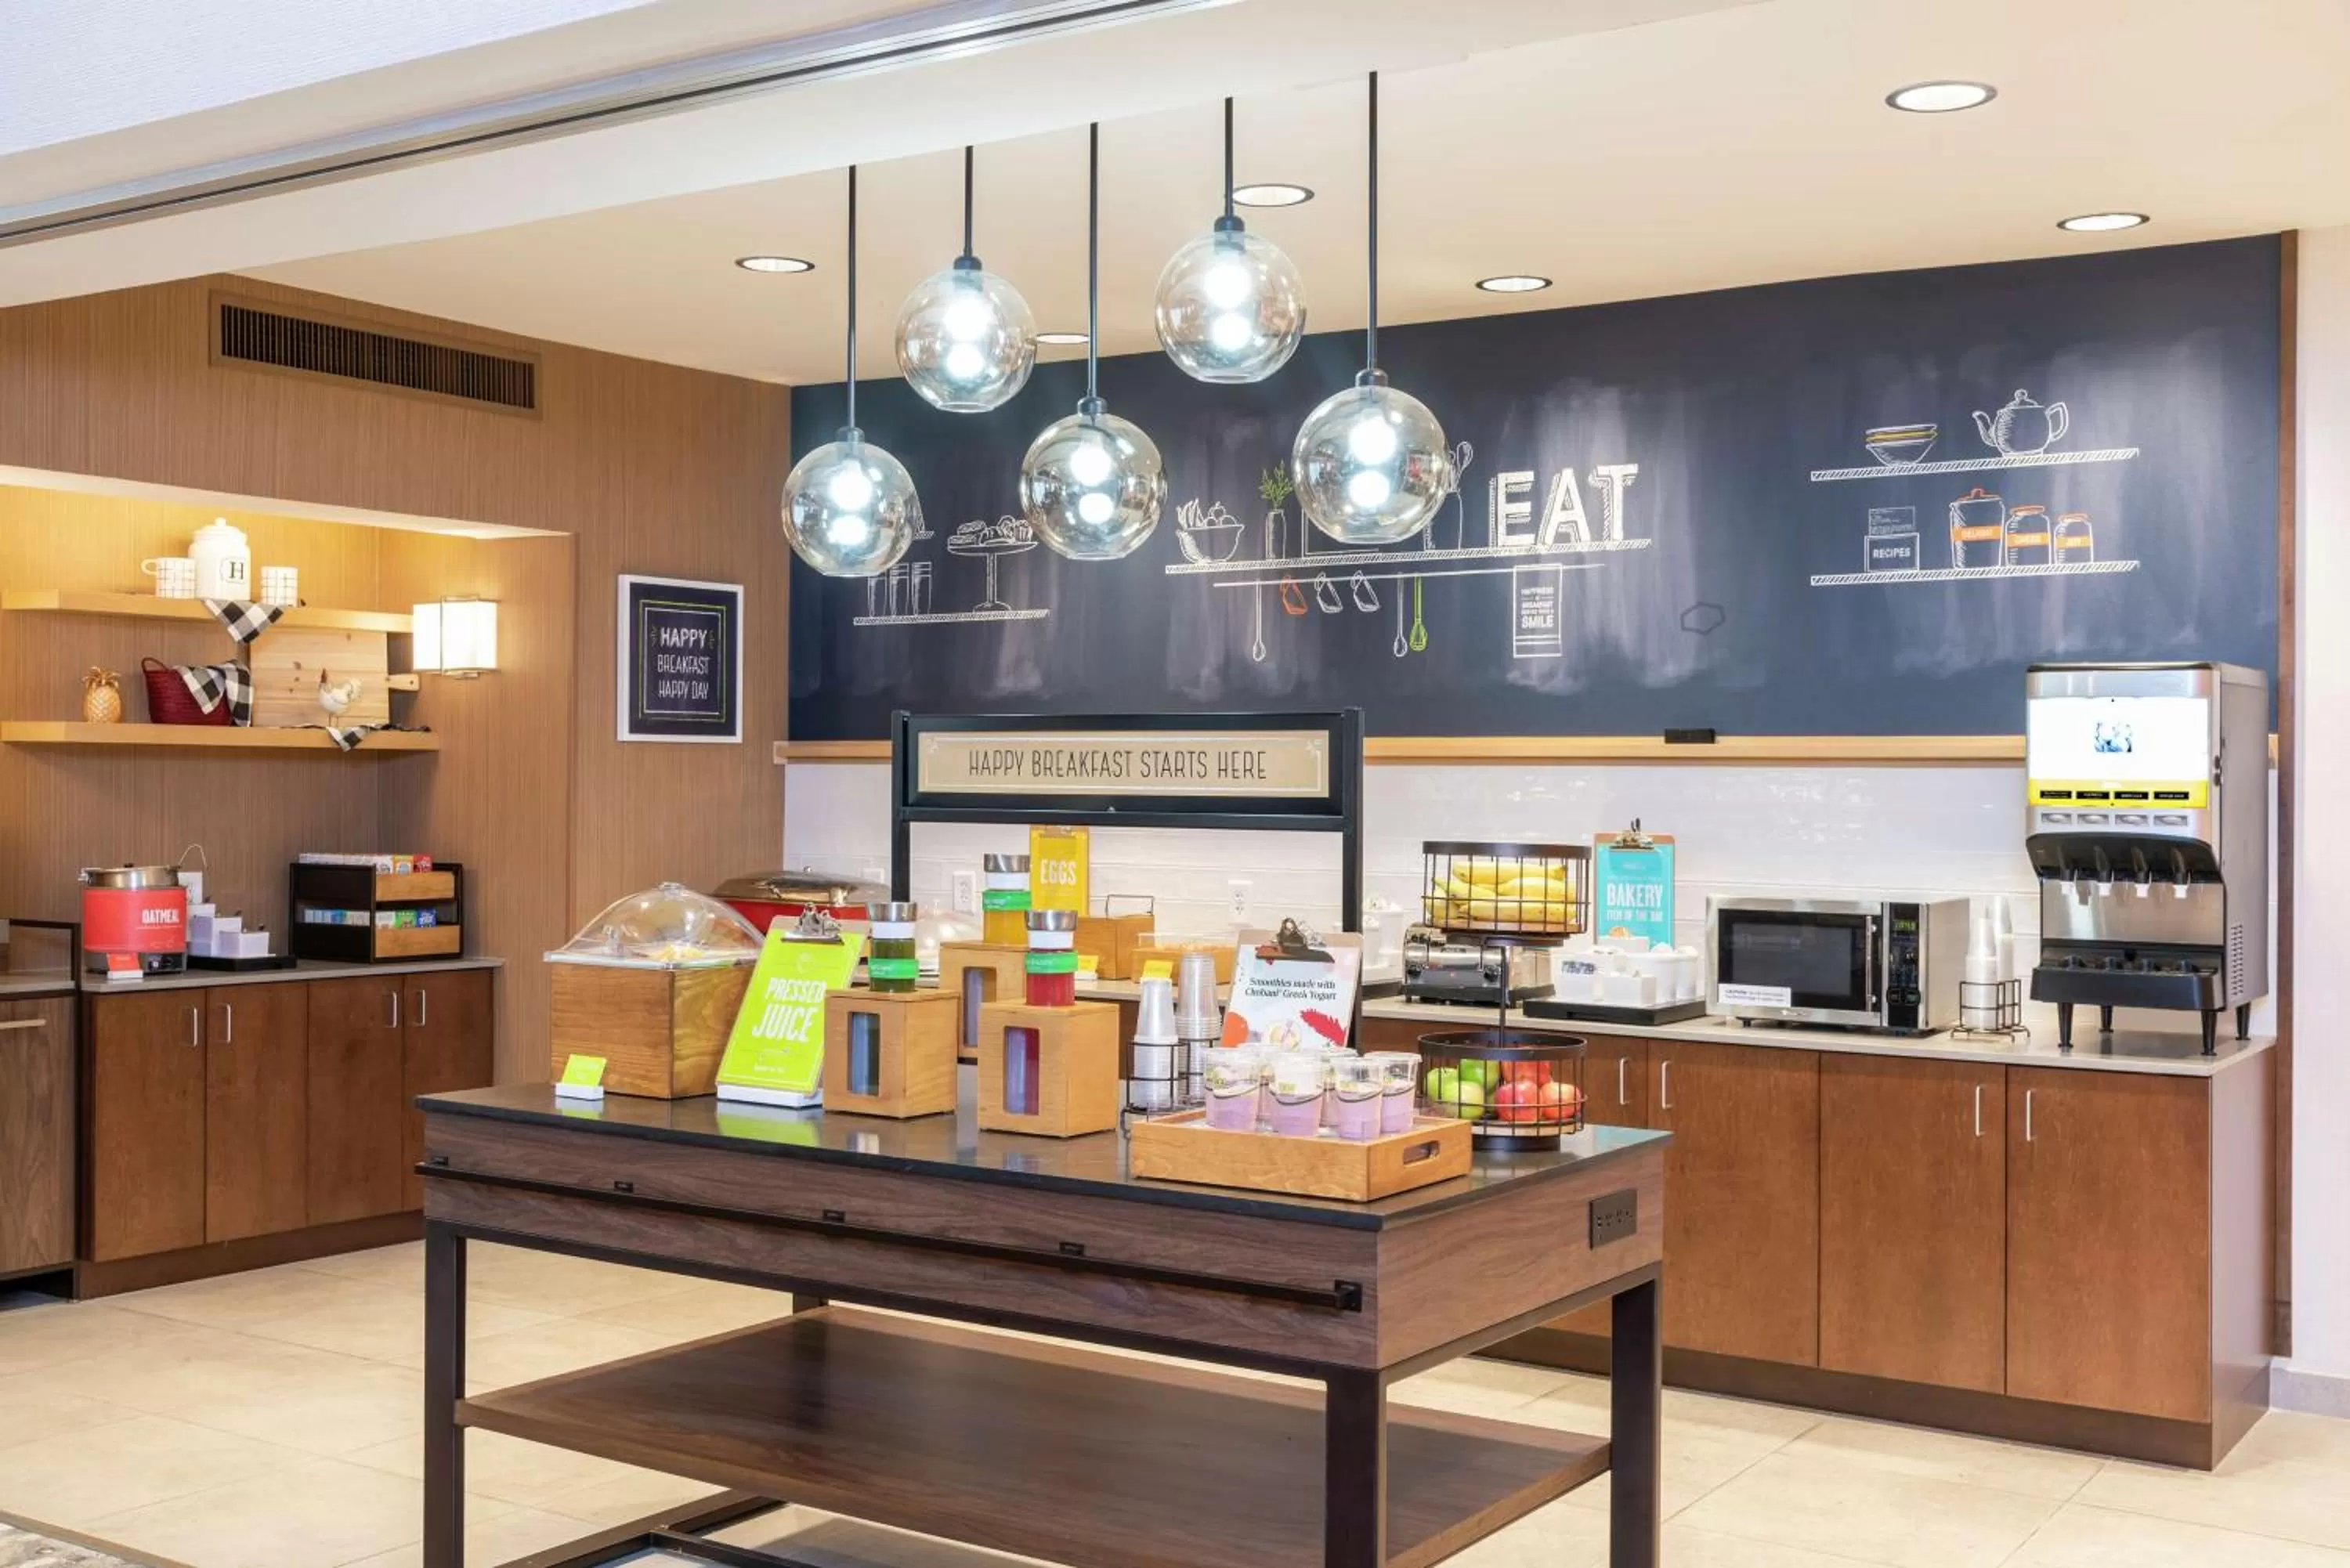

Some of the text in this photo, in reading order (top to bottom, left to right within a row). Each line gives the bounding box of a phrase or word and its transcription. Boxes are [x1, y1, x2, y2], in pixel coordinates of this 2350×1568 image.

[1489, 464, 1639, 547] EAT
[1872, 547, 1911, 558] RECIPES
[228, 561, 244, 580] H
[1522, 615, 1554, 628] SMILE
[660, 627, 707, 649] HAPPY
[657, 654, 710, 674] BREAKFAST
[658, 679, 709, 699] HAPPY DAY
[969, 750, 1267, 779] HAPPY BREAKFAST STARTS HERE
[1040, 859, 1078, 886] EGGS
[1607, 883, 1663, 909] BAKERY
[765, 977, 826, 1003] PRESSED
[1249, 977, 1336, 989] Smoothies made with
[1282, 989, 1307, 999] Greek
[1309, 990, 1337, 1002] Yogurt
[751, 1003, 819, 1043] JUICE
